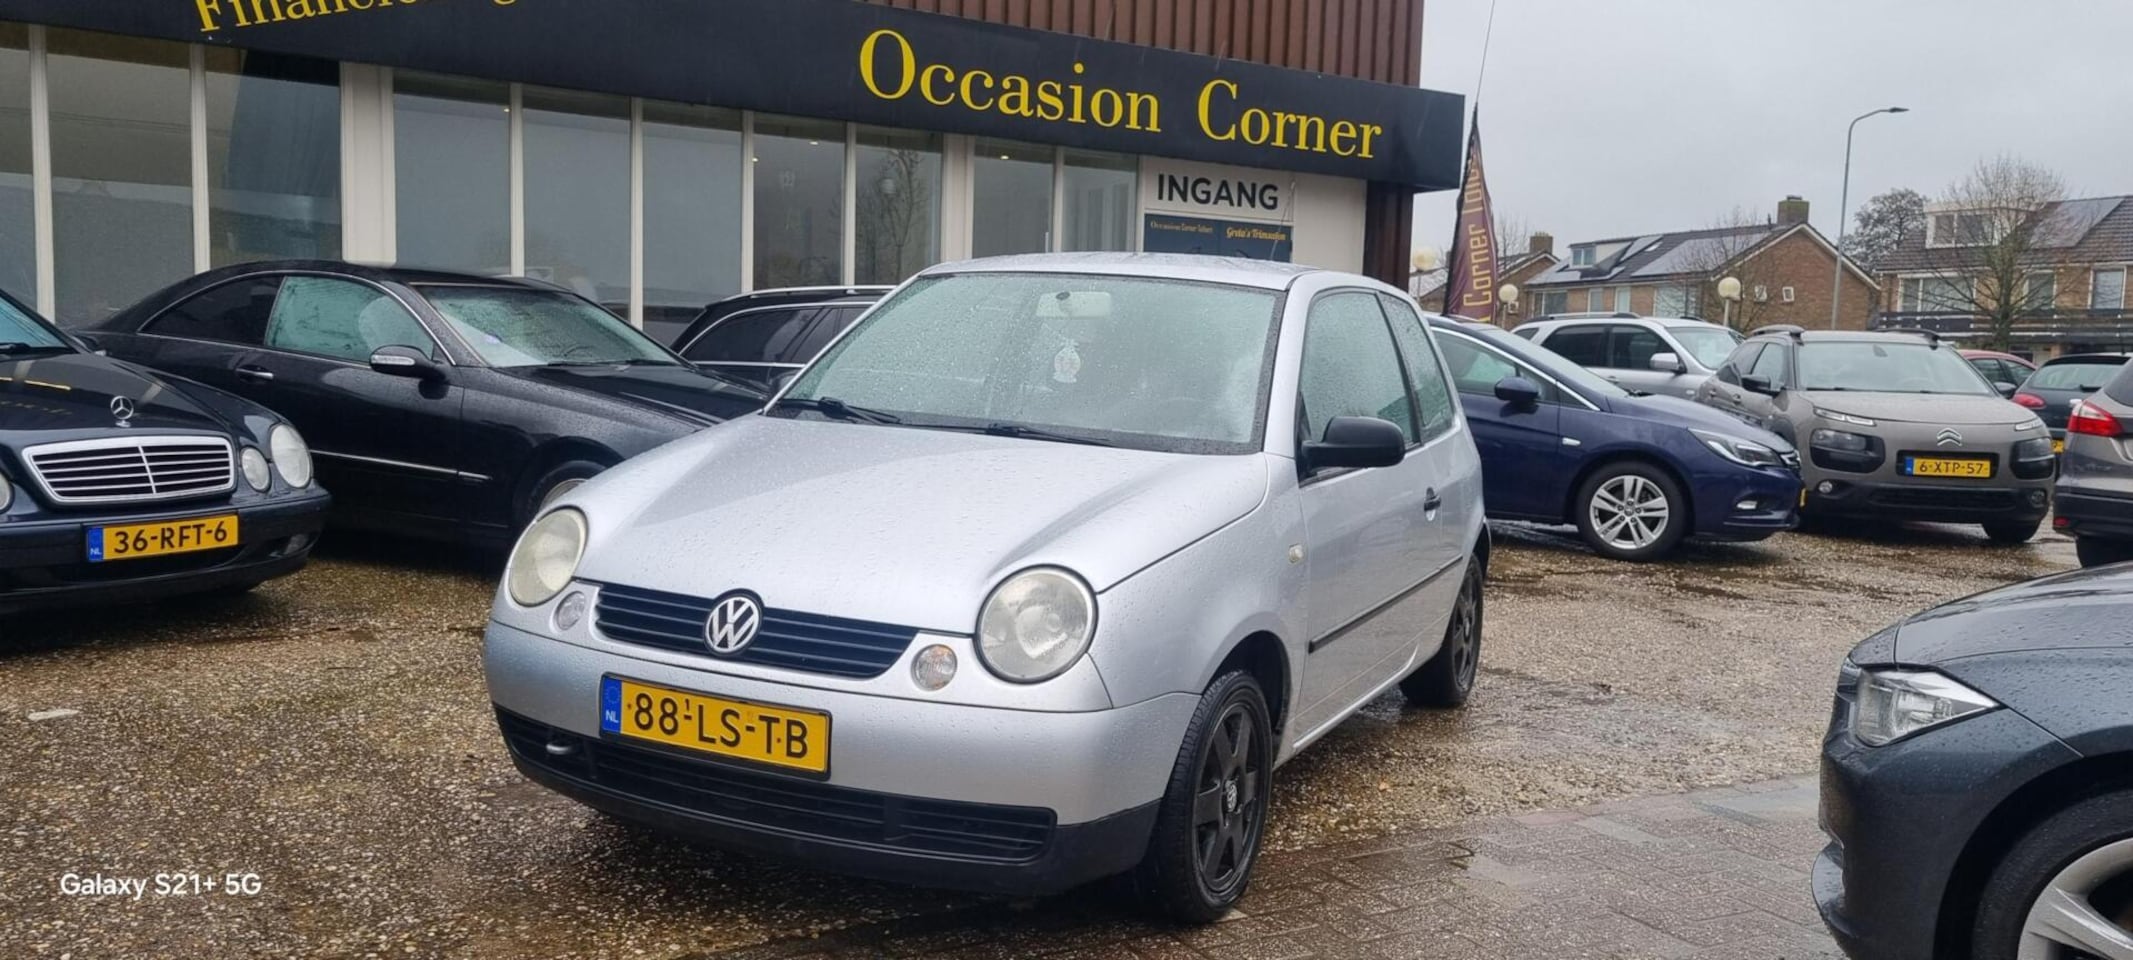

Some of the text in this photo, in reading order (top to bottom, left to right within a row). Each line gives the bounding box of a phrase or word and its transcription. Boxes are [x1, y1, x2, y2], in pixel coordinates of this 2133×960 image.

[859, 29, 1382, 158] Occasion Corner
[1157, 173, 1278, 210] INGANG
[1463, 223, 1491, 306] Corner
[1919, 461, 1984, 474] 6-XTP-57
[114, 521, 227, 553] 36-RFT-6
[605, 709, 619, 724] NL
